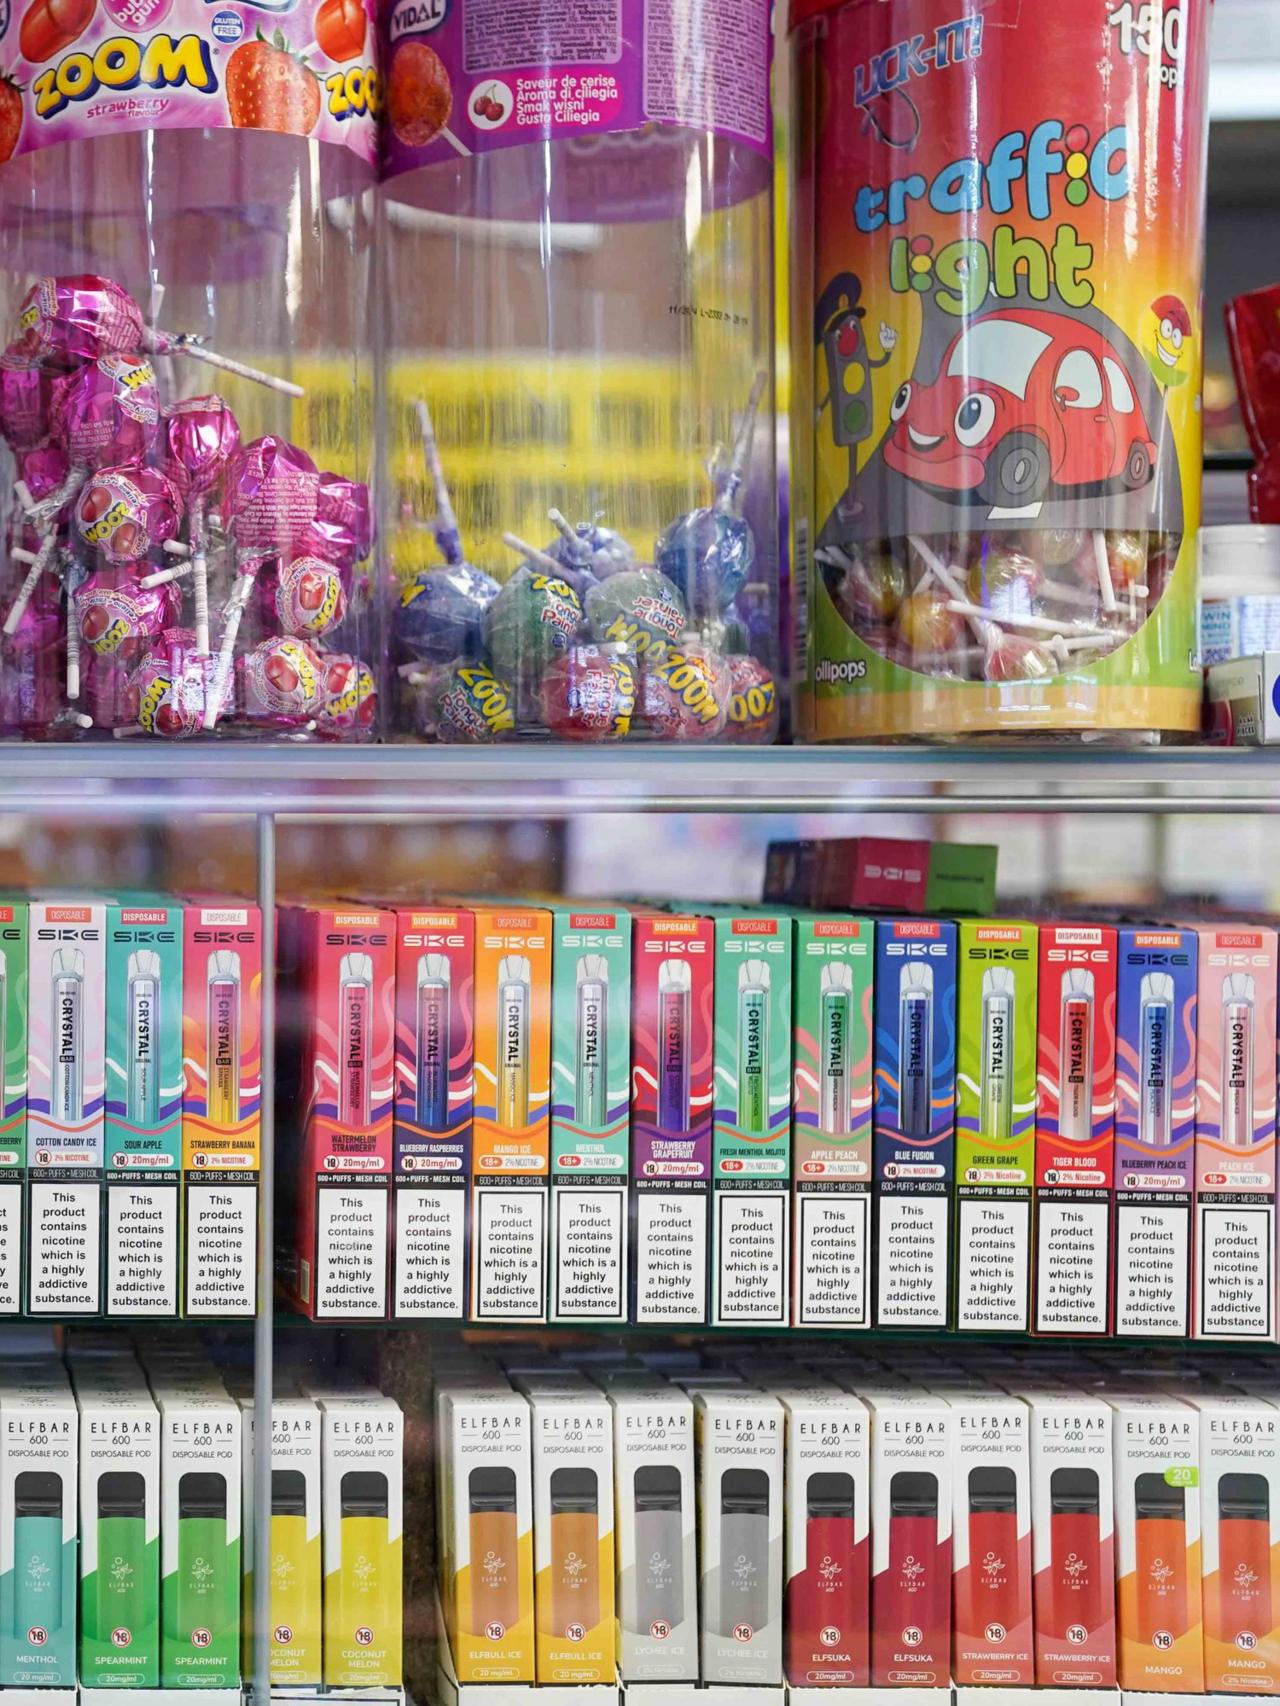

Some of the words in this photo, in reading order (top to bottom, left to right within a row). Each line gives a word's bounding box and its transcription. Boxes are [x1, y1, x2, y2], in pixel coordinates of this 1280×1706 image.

[394, 0, 441, 30] VIDAL
[213, 18, 240, 26] GLUTEN
[217, 27, 238, 36] FREE
[32, 34, 219, 120] ZOOM
[516, 79, 558, 90] Saveur
[561, 75, 576, 87] de
[580, 74, 615, 86] cerise
[517, 91, 556, 101] Aroma
[560, 87, 571, 99] di
[575, 87, 617, 101] ciliegia
[86, 97, 170, 119] strawberry
[517, 101, 549, 113] Smak
[127, 108, 162, 118] flavour
[517, 113, 551, 125] Gusto
[555, 110, 600, 124] Ciliegia
[853, 120, 1136, 233] traffic
[889, 224, 1094, 316] light
[816, 661, 866, 683] ollipops
[458, 665, 517, 734] ZOOM
[1057, 930, 1101, 942] DISPOSABLE
[36, 1138, 58, 1147] COTTON
[60, 1138, 85, 1147] CANDY
[86, 1138, 96, 1147] ICE
[124, 1140, 141, 1149] SOUR
[143, 1140, 162, 1149] APPLE
[191, 1140, 230, 1149] STRAWBERRY
[232, 1140, 255, 1149] BANANA
[895, 1151, 911, 1160] BLUE
[913, 1151, 934, 1160] FUSION
[972, 1156, 994, 1165] GREEN
[996, 1156, 1019, 1165] GRAPE
[1053, 1158, 1074, 1166] TIGER
[1075, 1158, 1096, 1167] BLOOD
[461, 1416, 522, 1430] ELFBAR
[482, 1430, 501, 1440] 600
[461, 1445, 503, 1453] DISPOSABLE
[506, 1444, 522, 1452] POD
[342, 1651, 386, 1659] COCONUT
[812, 1654, 851, 1662] ELFSUKA
[1044, 1654, 1096, 1662] STRAWBERRY
[95, 1656, 147, 1665] SPEARMINT
[348, 1660, 380, 1668] MELON
[1145, 1666, 1182, 1675] MANGO
